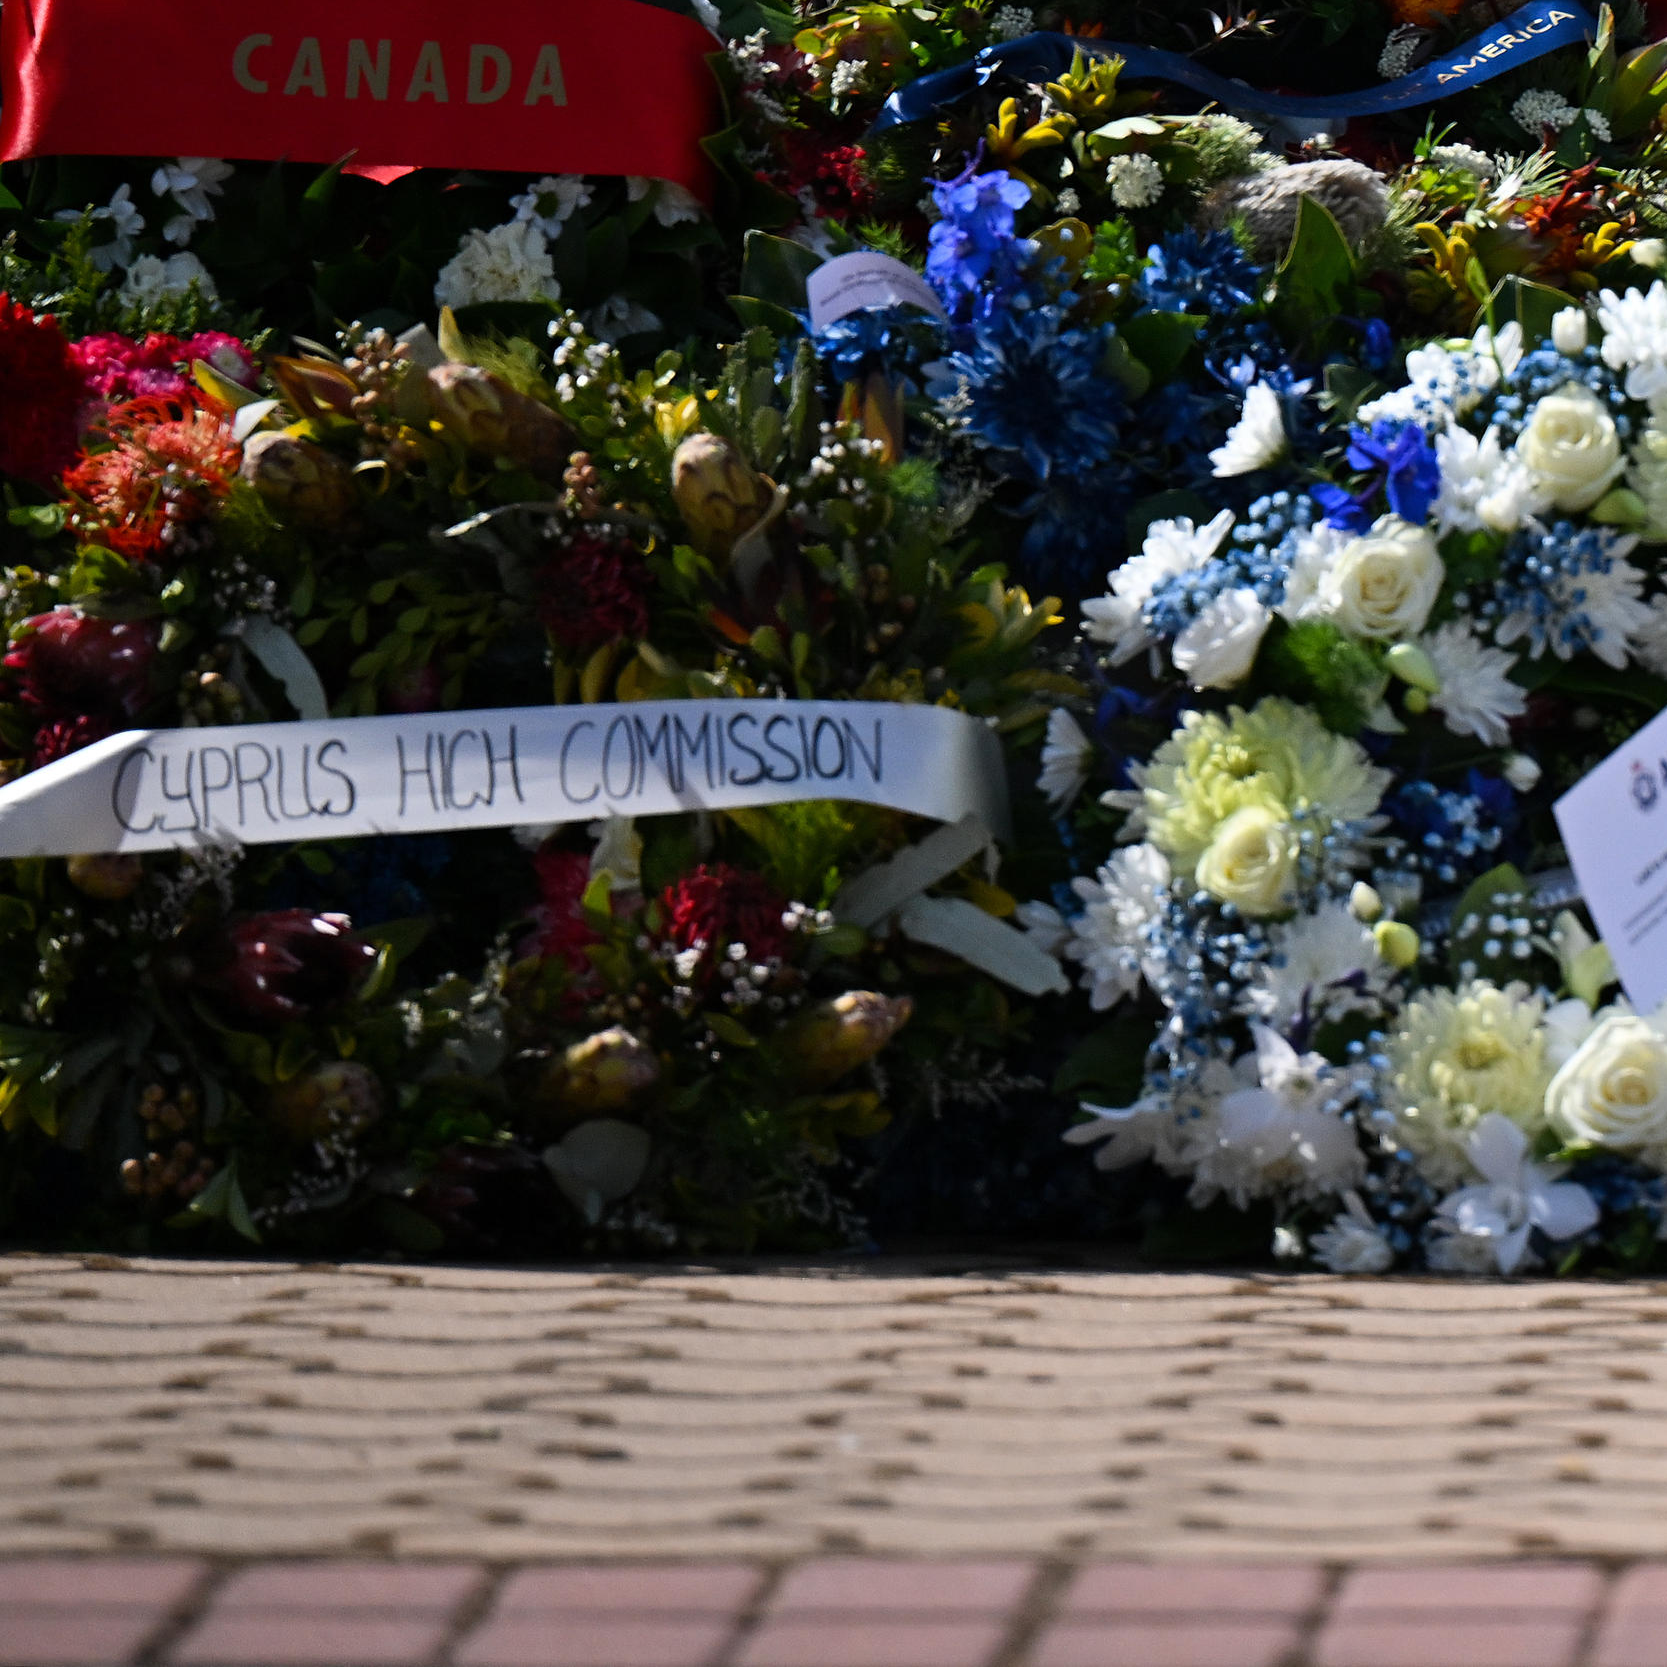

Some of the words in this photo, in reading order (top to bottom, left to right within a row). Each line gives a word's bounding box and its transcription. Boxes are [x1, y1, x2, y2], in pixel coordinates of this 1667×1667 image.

[232, 33, 568, 107] CANADA
[1436, 9, 1577, 85] AMERICA
[112, 738, 357, 833] CYPRUS
[560, 712, 884, 804] COMMISSION
